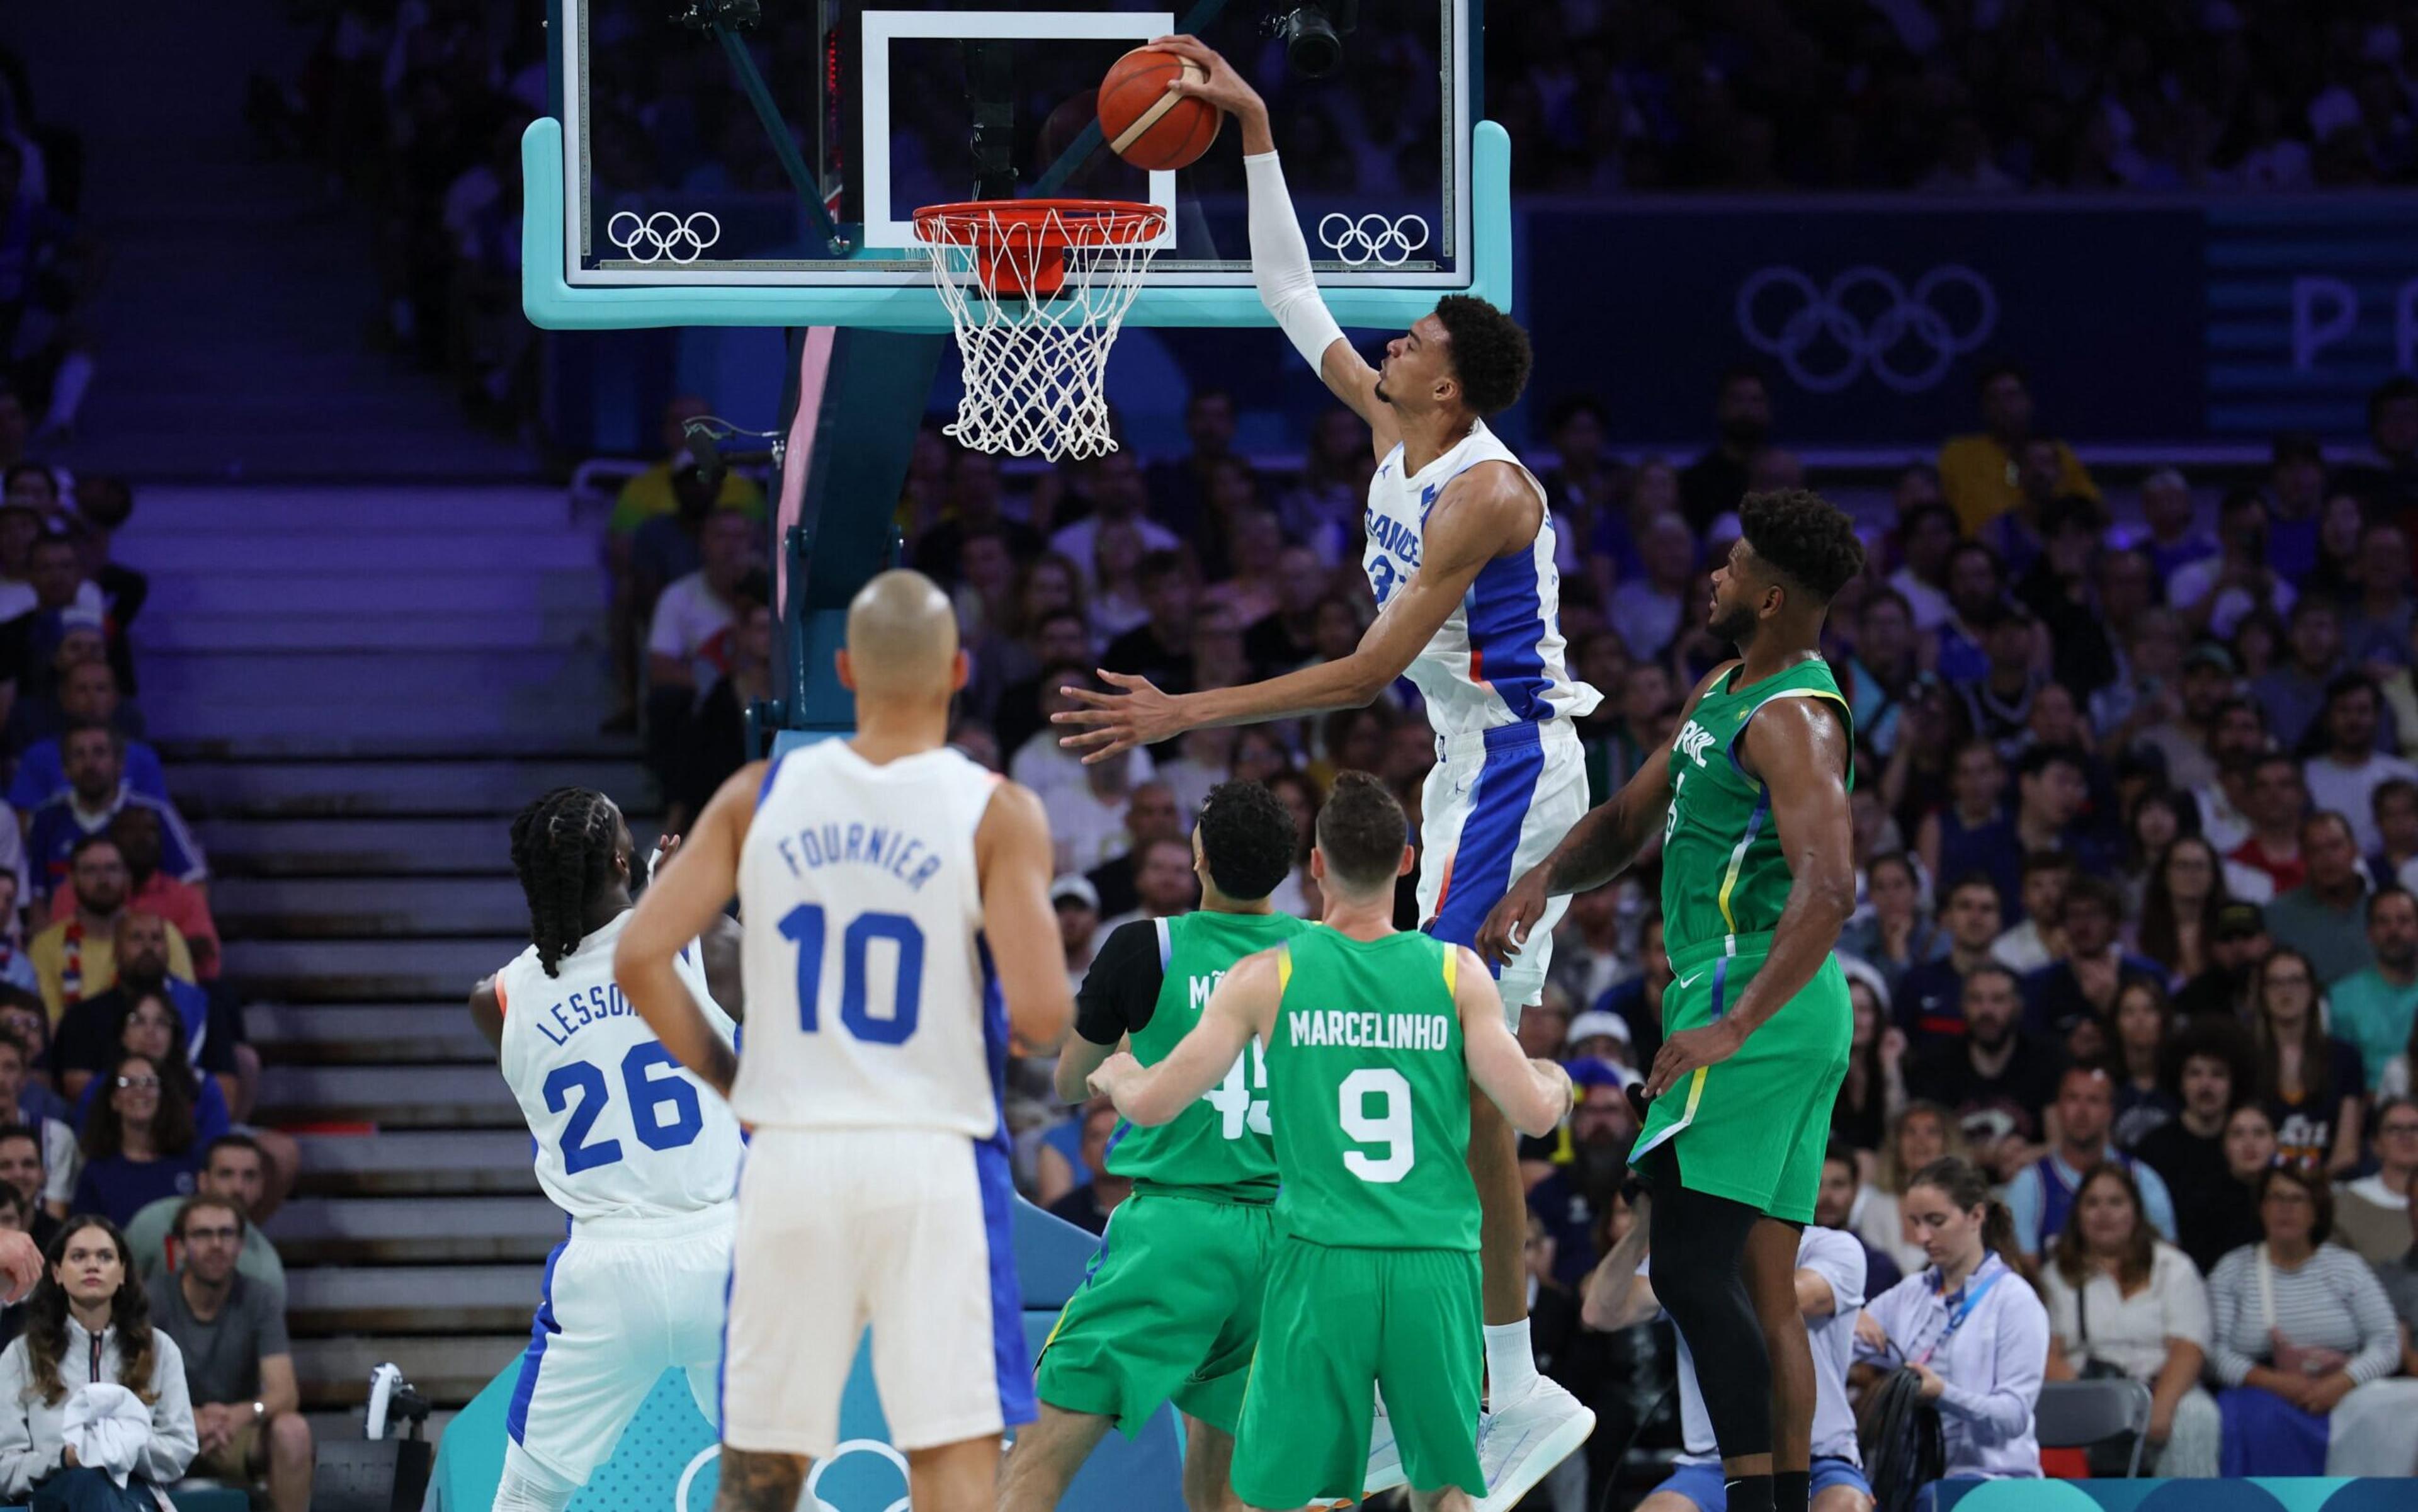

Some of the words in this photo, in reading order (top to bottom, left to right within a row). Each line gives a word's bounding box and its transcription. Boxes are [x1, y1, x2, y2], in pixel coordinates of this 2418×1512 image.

[1368, 555, 1407, 603] 3
[778, 823, 941, 892] FOURNIER
[777, 902, 924, 1045] 10
[536, 982, 639, 1047] LESSO
[1289, 1010, 1448, 1051] MARCELINHO
[542, 1039, 703, 1176] 26
[1339, 1068, 1414, 1183] 9
